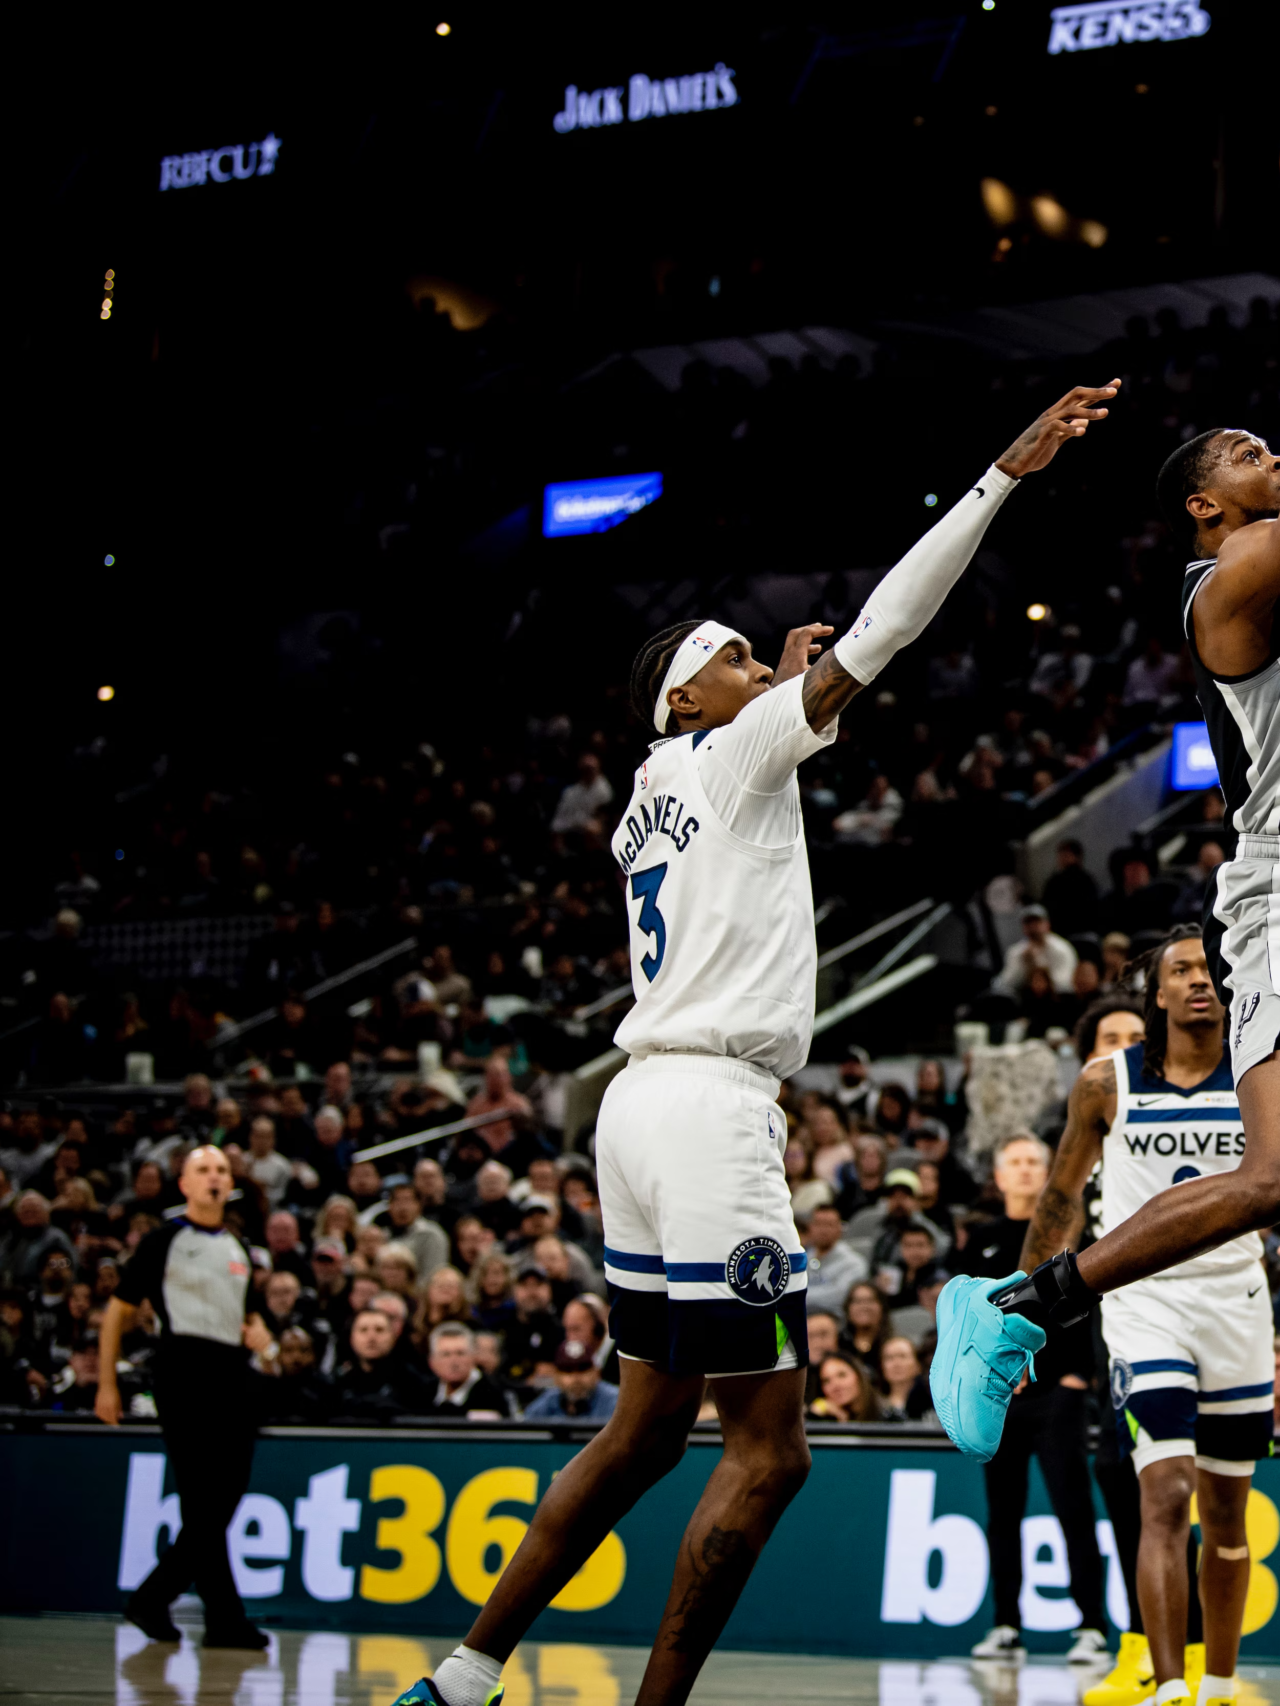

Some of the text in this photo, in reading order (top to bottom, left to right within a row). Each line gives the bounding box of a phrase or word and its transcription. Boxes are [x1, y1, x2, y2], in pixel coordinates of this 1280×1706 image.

[629, 861, 669, 984] 3
[1123, 1132, 1246, 1157] WOLVES
[728, 1238, 789, 1291] MINNESOTA TIMBERWOLVES
